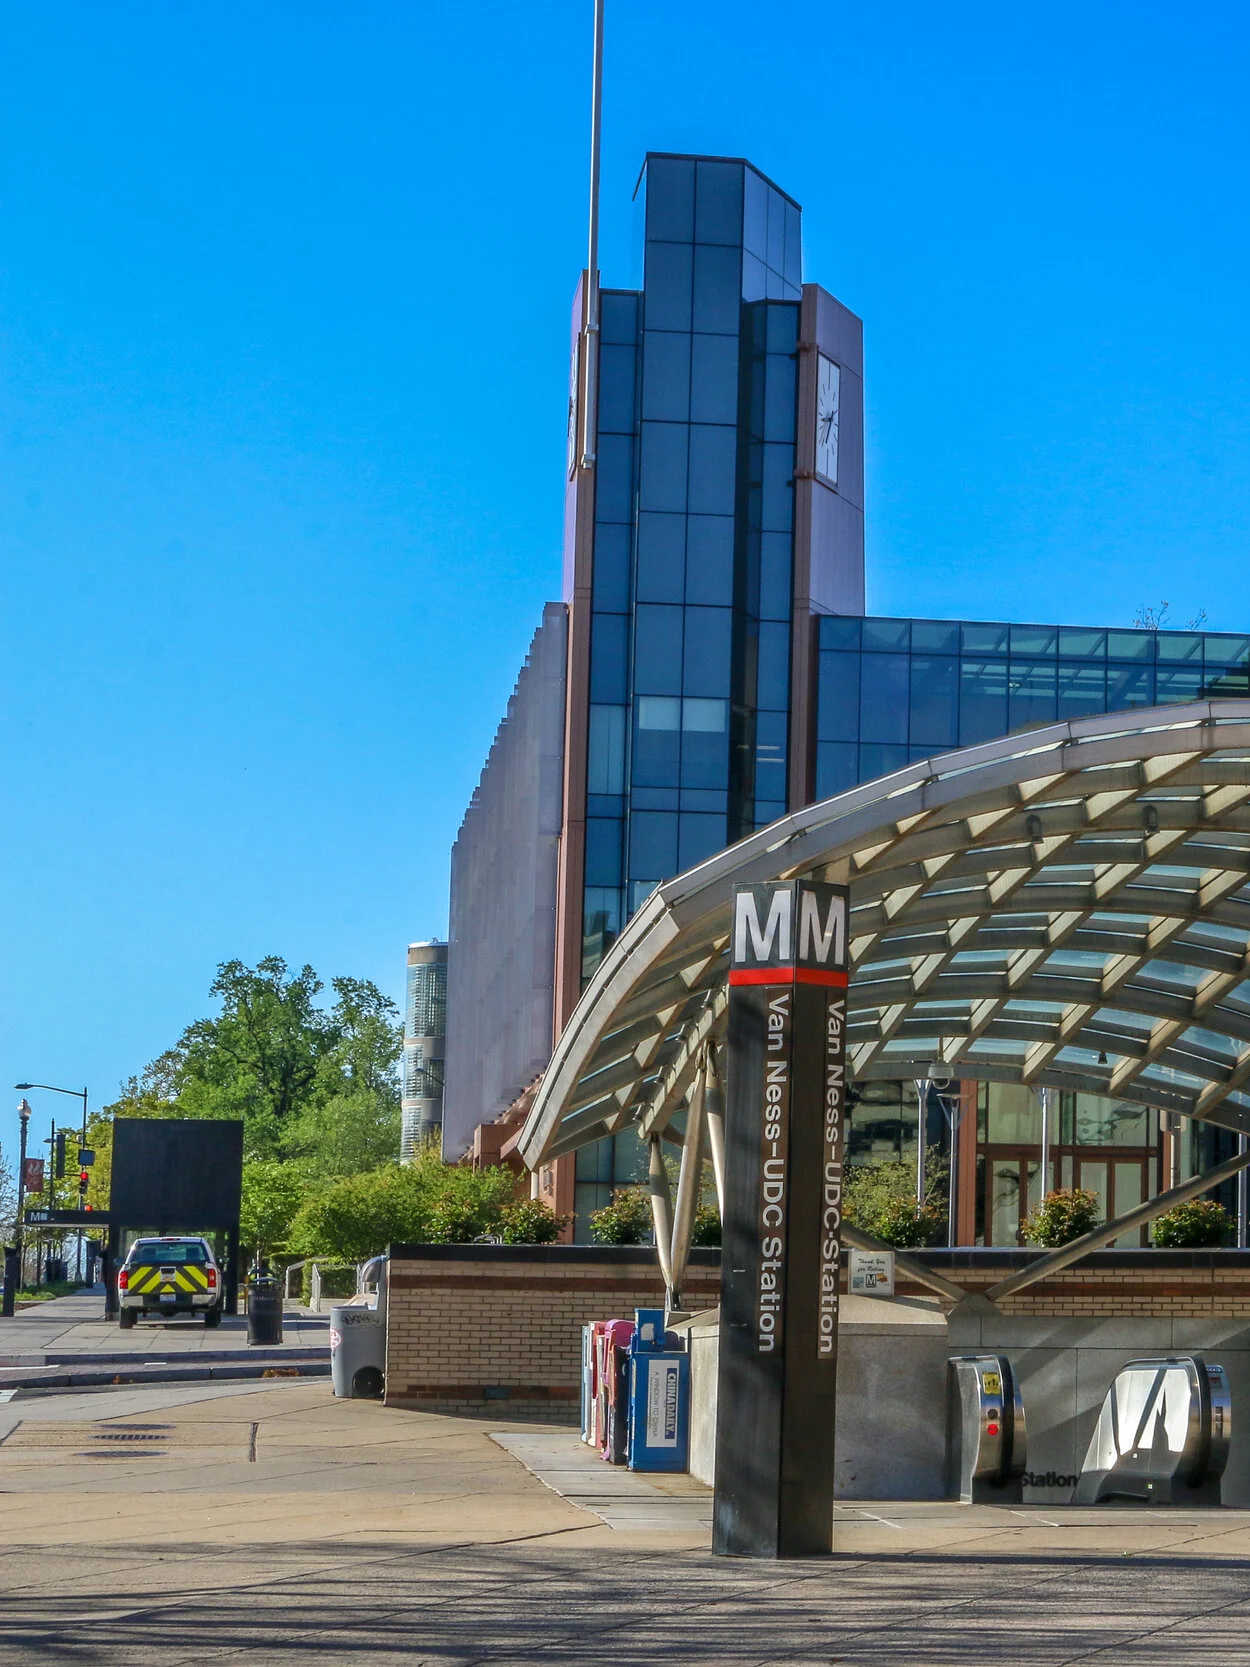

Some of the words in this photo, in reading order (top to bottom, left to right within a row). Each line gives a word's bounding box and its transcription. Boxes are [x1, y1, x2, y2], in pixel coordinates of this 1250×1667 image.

[735, 890, 791, 962] M
[800, 890, 845, 965] M
[767, 993, 790, 1051] Van
[828, 1000, 845, 1055] Van
[758, 1237, 783, 1352] Station
[1021, 1471, 1078, 1487] Station
